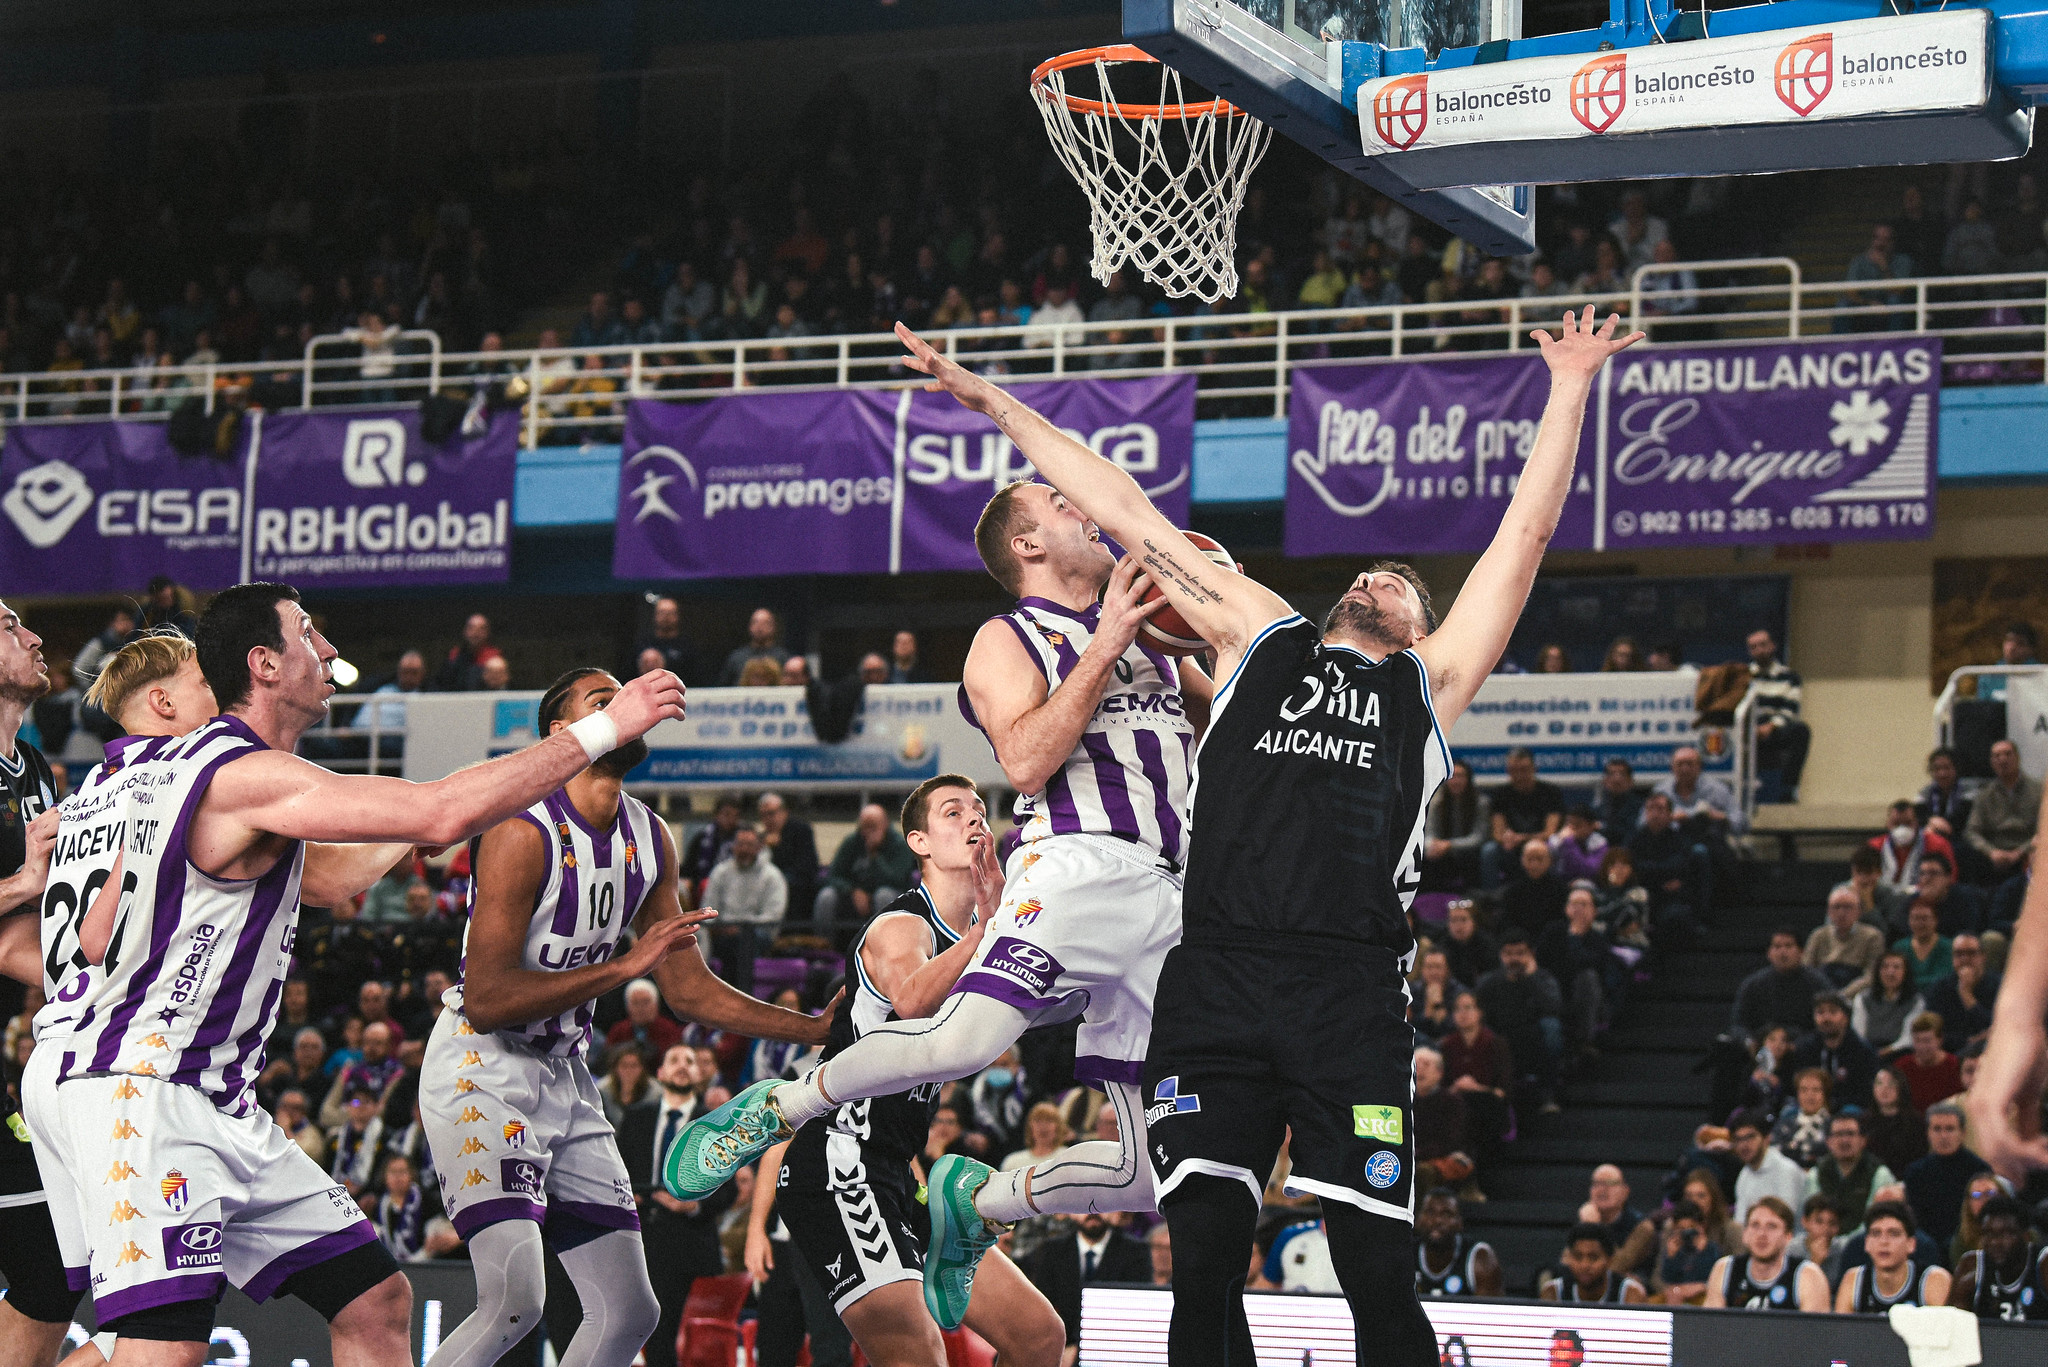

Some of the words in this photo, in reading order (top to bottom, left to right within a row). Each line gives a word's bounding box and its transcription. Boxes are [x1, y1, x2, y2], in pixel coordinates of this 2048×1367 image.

[1842, 75, 1894, 88] ESPAÑA
[1635, 94, 1684, 107] ESPAÑA
[1436, 113, 1484, 125] ESPAÑA
[1619, 349, 1931, 396] AMBULANCIAS
[1406, 404, 1465, 465] del
[1614, 398, 1846, 504] Enrique
[97, 487, 241, 537] EISA
[704, 476, 893, 519] prevenges
[255, 500, 508, 553] RBHGlobal
[1688, 510, 1726, 532] 112
[1887, 502, 1927, 526] 170
[1093, 693, 1182, 716] EMC
[1326, 689, 1380, 727] HLA
[1467, 697, 1590, 715] undación
[1091, 715, 1186, 728] NIVERSIDAD
[1508, 721, 1539, 736] de
[1253, 729, 1376, 769] ALICANTE
[589, 881, 614, 931] 10
[171, 924, 215, 1002] aspasia
[991, 958, 1046, 989] HYUNDAI
[1374, 1152, 1398, 1166] LUCENTUM
[1368, 1174, 1391, 1186] ALICANTE
[177, 1253, 223, 1266] HYUND
[828, 1273, 857, 1300] CUPRA
